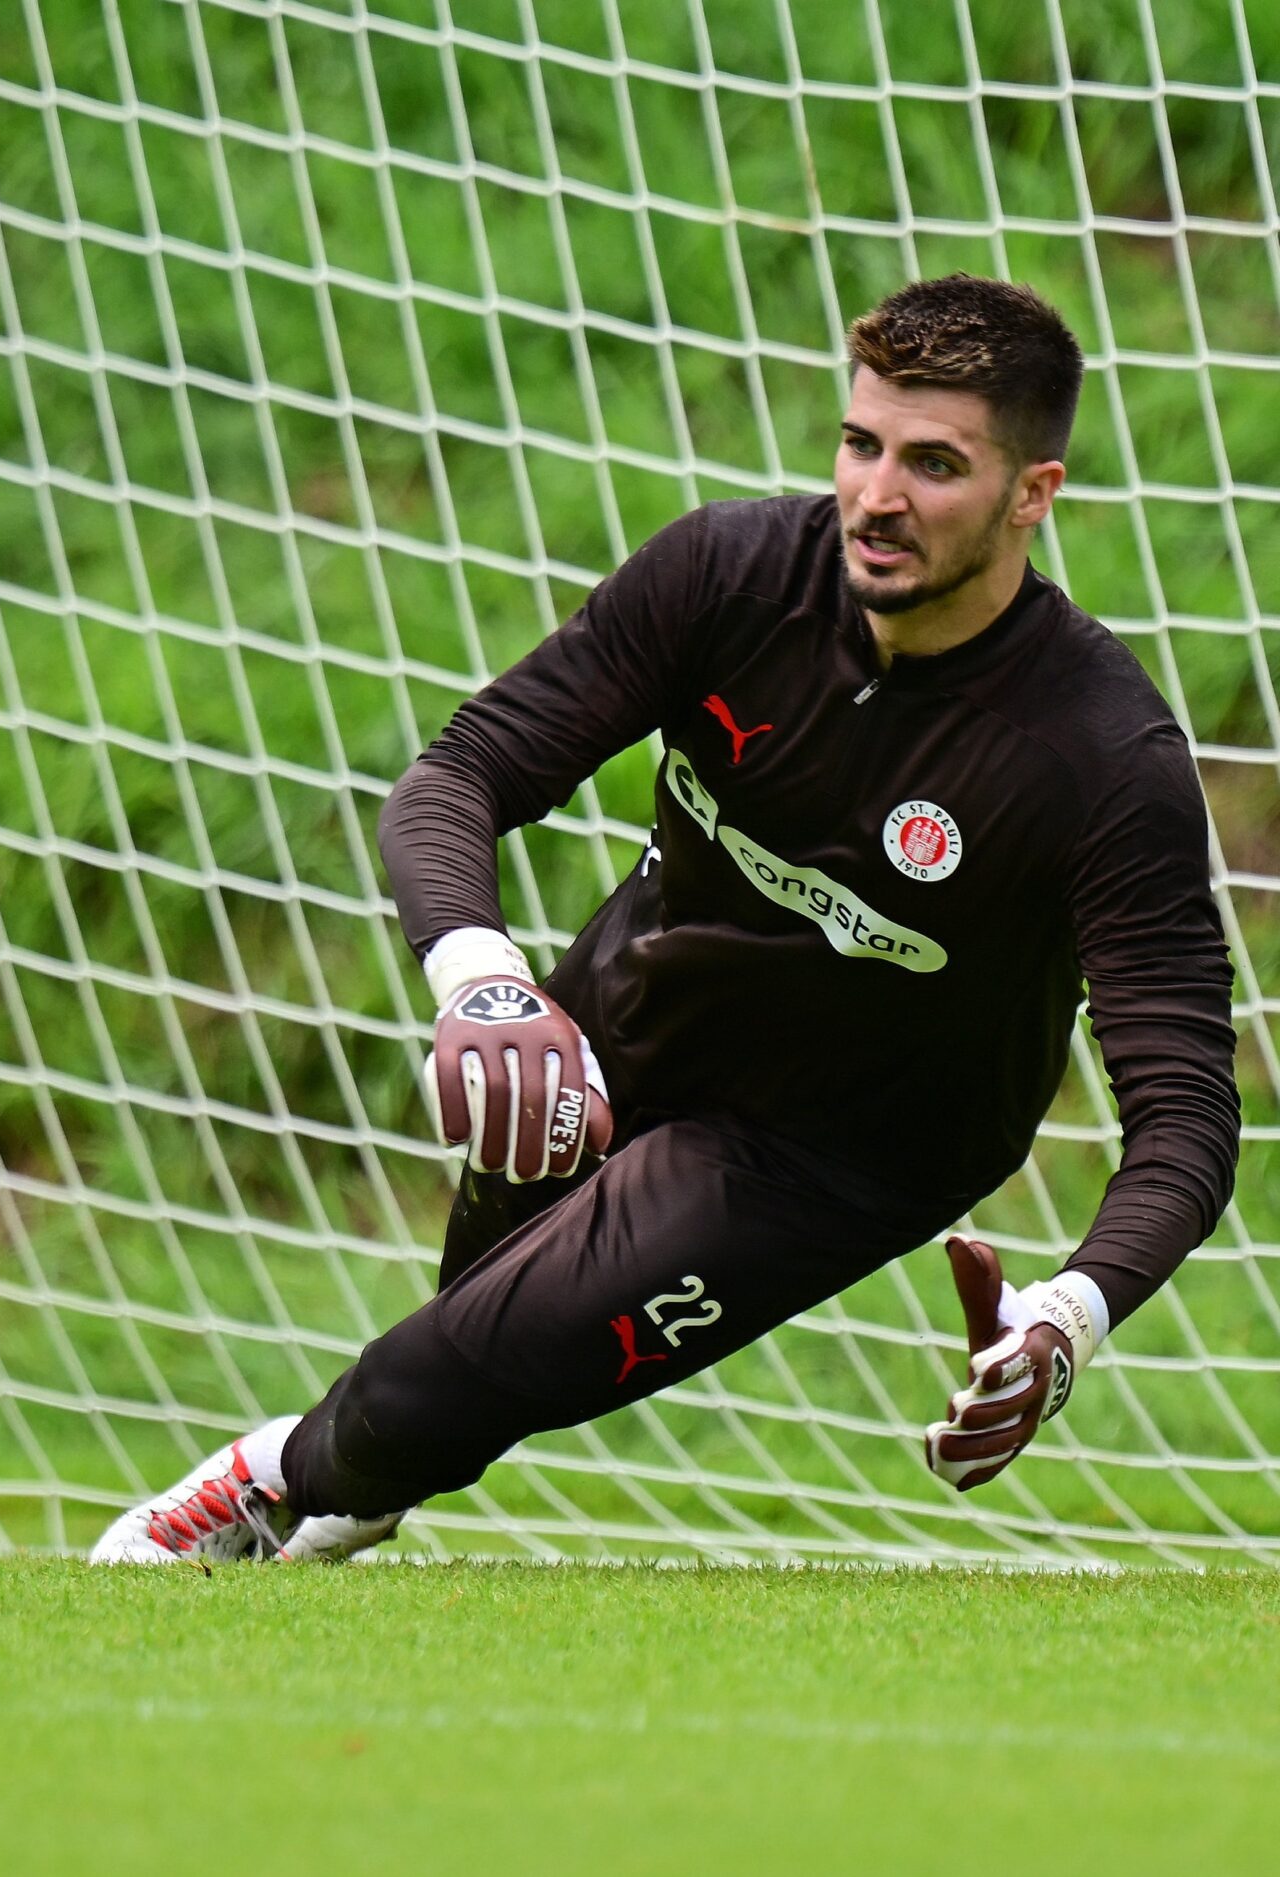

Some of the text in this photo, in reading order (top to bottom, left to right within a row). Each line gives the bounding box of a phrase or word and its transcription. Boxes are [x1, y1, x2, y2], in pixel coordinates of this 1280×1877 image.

[891, 804, 959, 855] FC ST. PAULI
[897, 858, 928, 879] 1910
[739, 846, 921, 957] congstar
[644, 1275, 723, 1348] 22
[1051, 1288, 1088, 1335] NIKOLA
